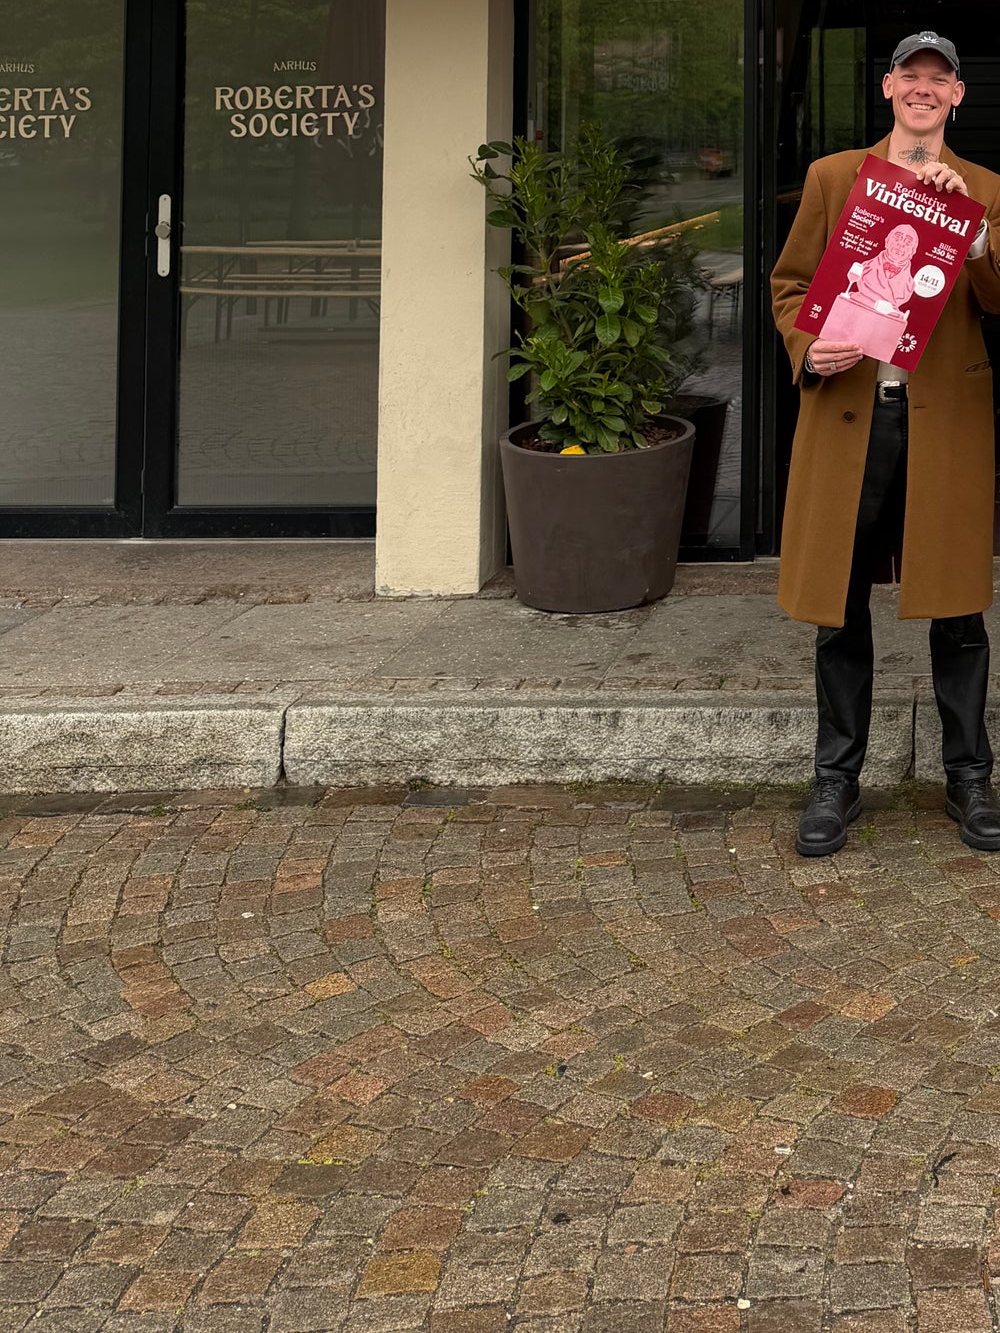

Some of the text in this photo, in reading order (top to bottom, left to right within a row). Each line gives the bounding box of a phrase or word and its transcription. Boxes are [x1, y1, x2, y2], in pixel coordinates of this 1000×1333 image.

[273, 60, 317, 72] AARHUS
[214, 84, 376, 110] ROBERTA'S
[230, 112, 360, 138] SOCIETY
[893, 182, 948, 212] Reduktivt
[854, 206, 885, 223] Roberta's
[866, 178, 971, 237] Vinfestival
[851, 211, 876, 228] Society
[931, 246, 946, 257] 350
[945, 252, 955, 261] kr.
[920, 274, 939, 287] 14/11
[812, 304, 822, 313] 20
